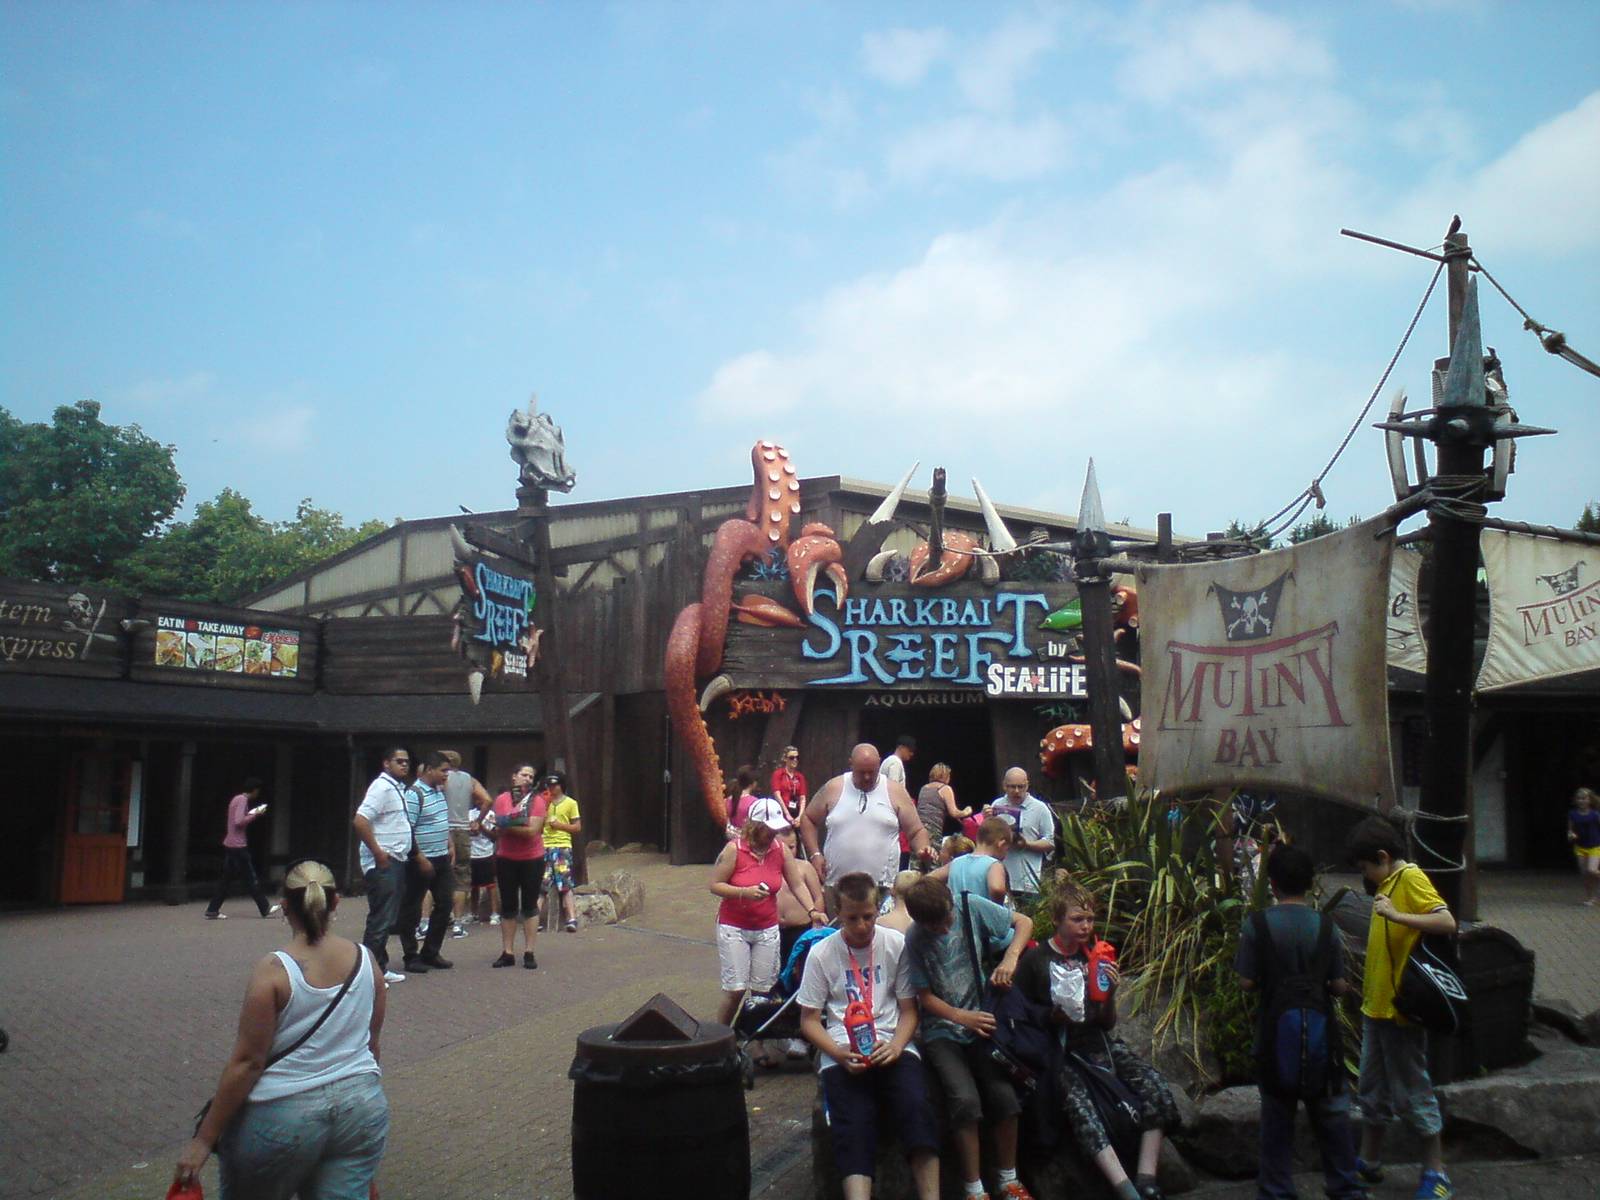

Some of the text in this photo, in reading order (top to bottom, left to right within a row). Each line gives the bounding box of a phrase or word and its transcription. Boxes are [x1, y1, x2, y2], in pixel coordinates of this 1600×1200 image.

[198, 621, 219, 633] TAKE
[219, 624, 245, 636] AWAY
[802, 588, 1050, 659] SHARKBAIT
[1564, 621, 1599, 648] BAY
[805, 628, 1014, 685] REEF
[1047, 640, 1067, 658] by
[1157, 621, 1352, 732] MUTINY
[863, 692, 986, 706] AQUARIUM
[1212, 725, 1282, 768] BAY
